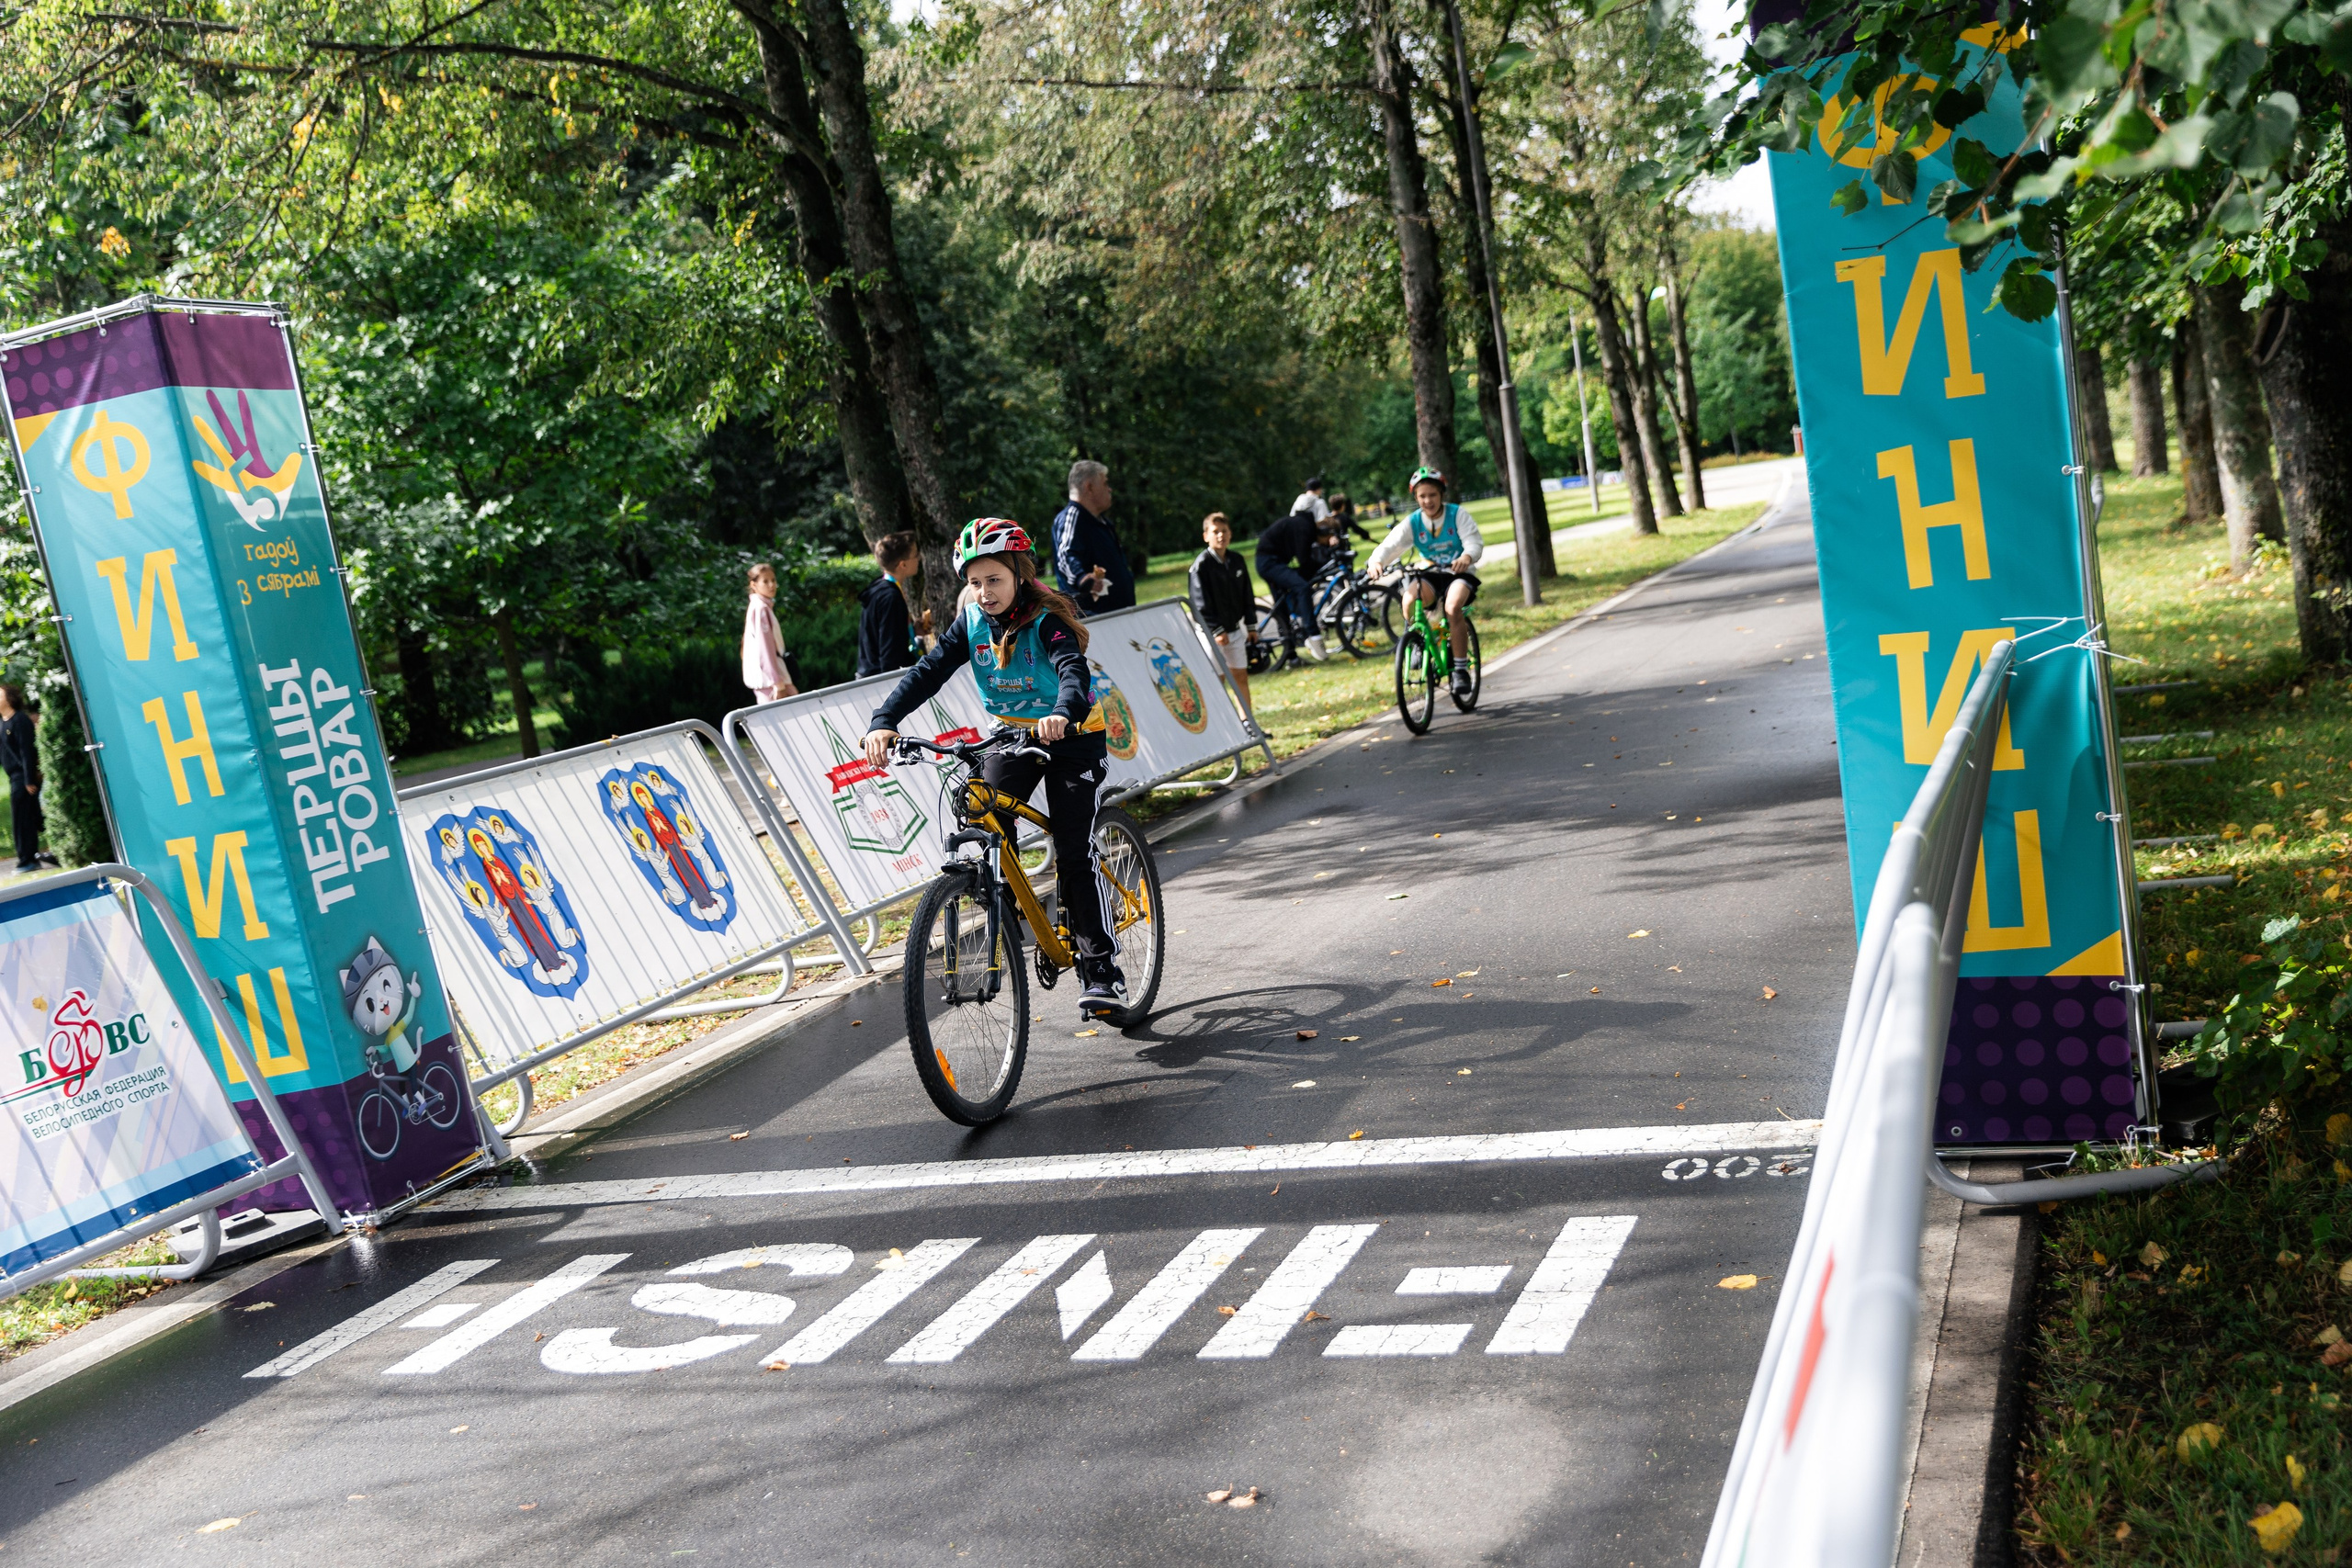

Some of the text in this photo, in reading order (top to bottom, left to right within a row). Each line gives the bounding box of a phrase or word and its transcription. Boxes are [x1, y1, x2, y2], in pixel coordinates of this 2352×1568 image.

[243, 536, 300, 568] гадоў
[256, 564, 321, 598] сябрамі
[70, 409, 311, 1085] ФИНИШ
[310, 667, 390, 873] РОВАР
[258, 658, 356, 915] ПЕРШЫ
[870, 809, 889, 823] 1938
[892, 853, 923, 874] МІНСК
[23, 1066, 167, 1125] БЕЛОРУССКАЯ ФЕДЕРАЦИЯ
[31, 1081, 171, 1139] ВЕЛОСИПЕДНОГО СПОРТА
[1661, 1153, 1814, 1180] 200
[242, 1214, 1638, 1377] FINISH
